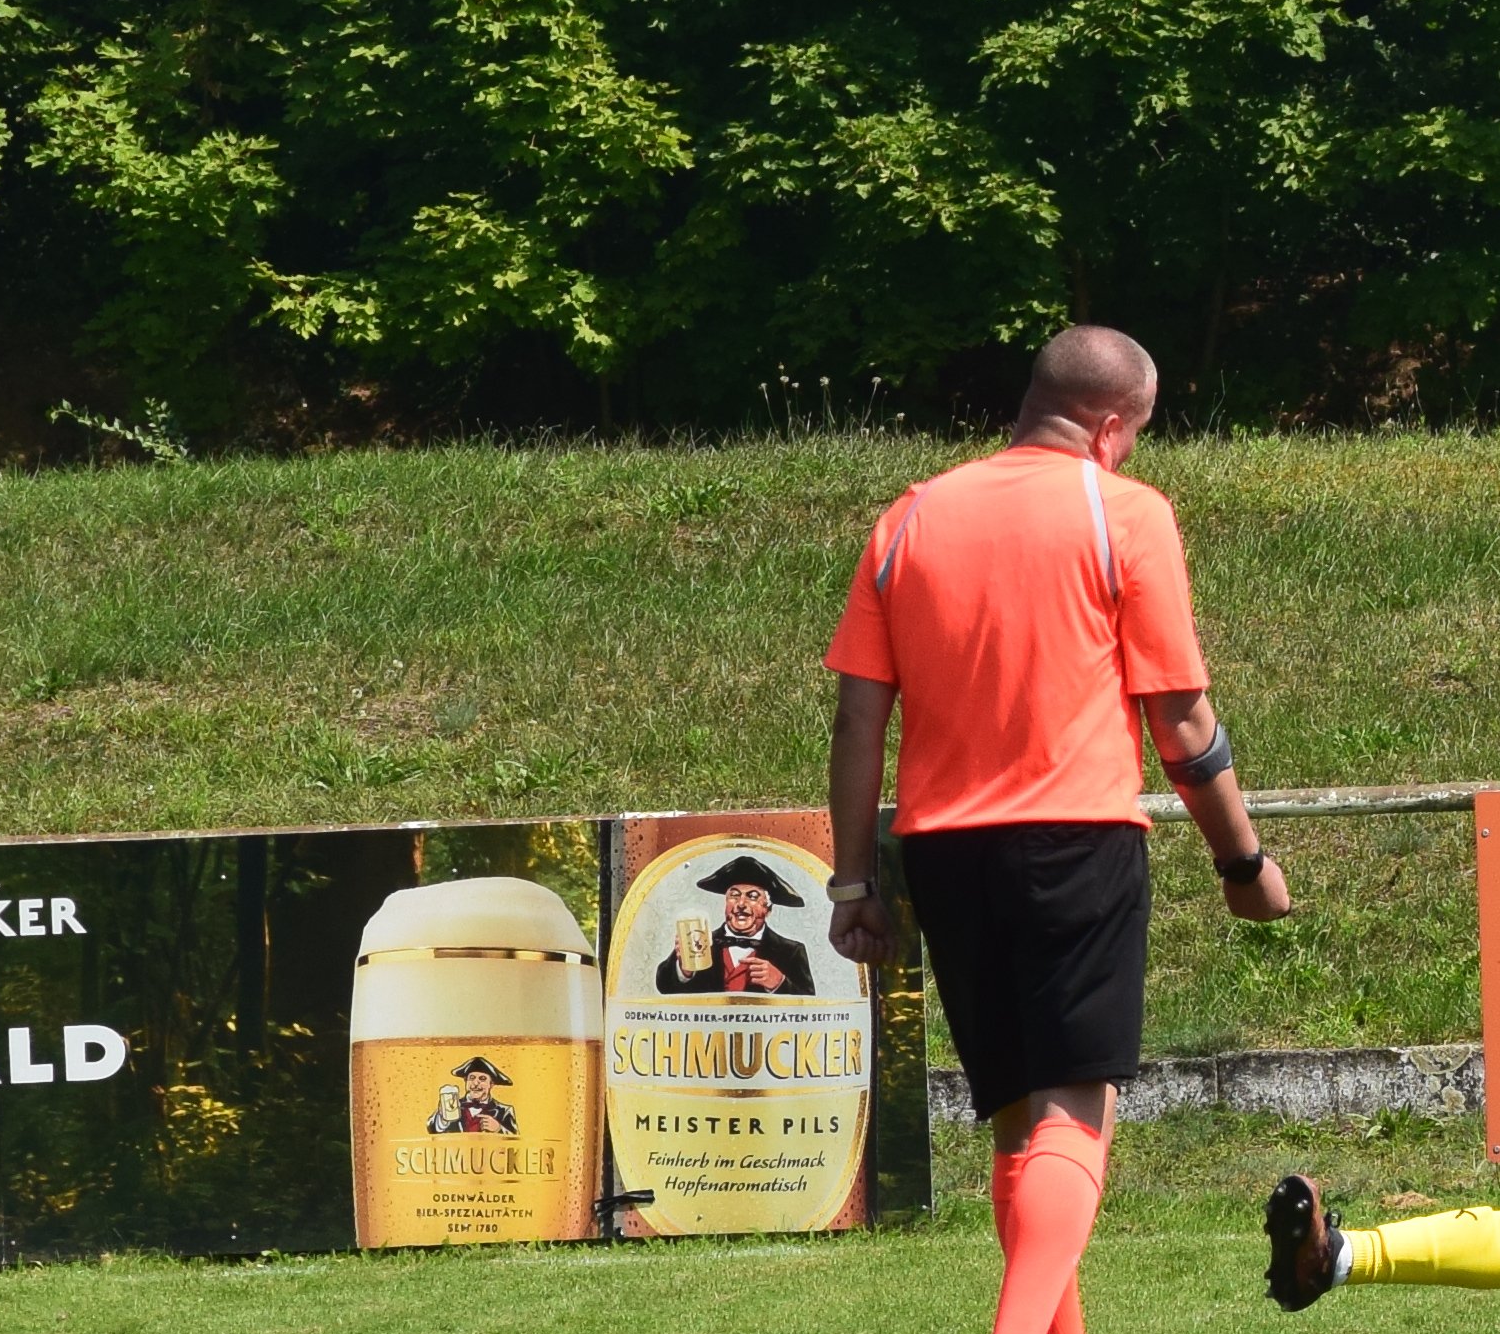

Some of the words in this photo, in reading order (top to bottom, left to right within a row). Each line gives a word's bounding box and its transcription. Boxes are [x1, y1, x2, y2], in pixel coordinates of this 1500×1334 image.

[624, 1011, 691, 1022] ODENWÄLDER
[694, 1012, 808, 1023] BIER-SPEZIALITÄTEN
[812, 1013, 831, 1022] SEIT
[833, 1012, 850, 1021] 1780
[613, 1026, 862, 1080] SCHMUCKER
[636, 1114, 765, 1134] MEISTER
[783, 1116, 840, 1134] PILS
[396, 1146, 555, 1175] SCHMUCKER
[647, 1151, 710, 1169] Feinherb
[714, 1154, 735, 1168] im
[740, 1151, 826, 1169] Geschmack
[665, 1175, 807, 1197] Hopfenaromatisch
[433, 1192, 515, 1204] ODENWÄLDER
[416, 1207, 533, 1218] BIER-SPEZIALITÄTEN
[475, 1223, 498, 1233] 1780
